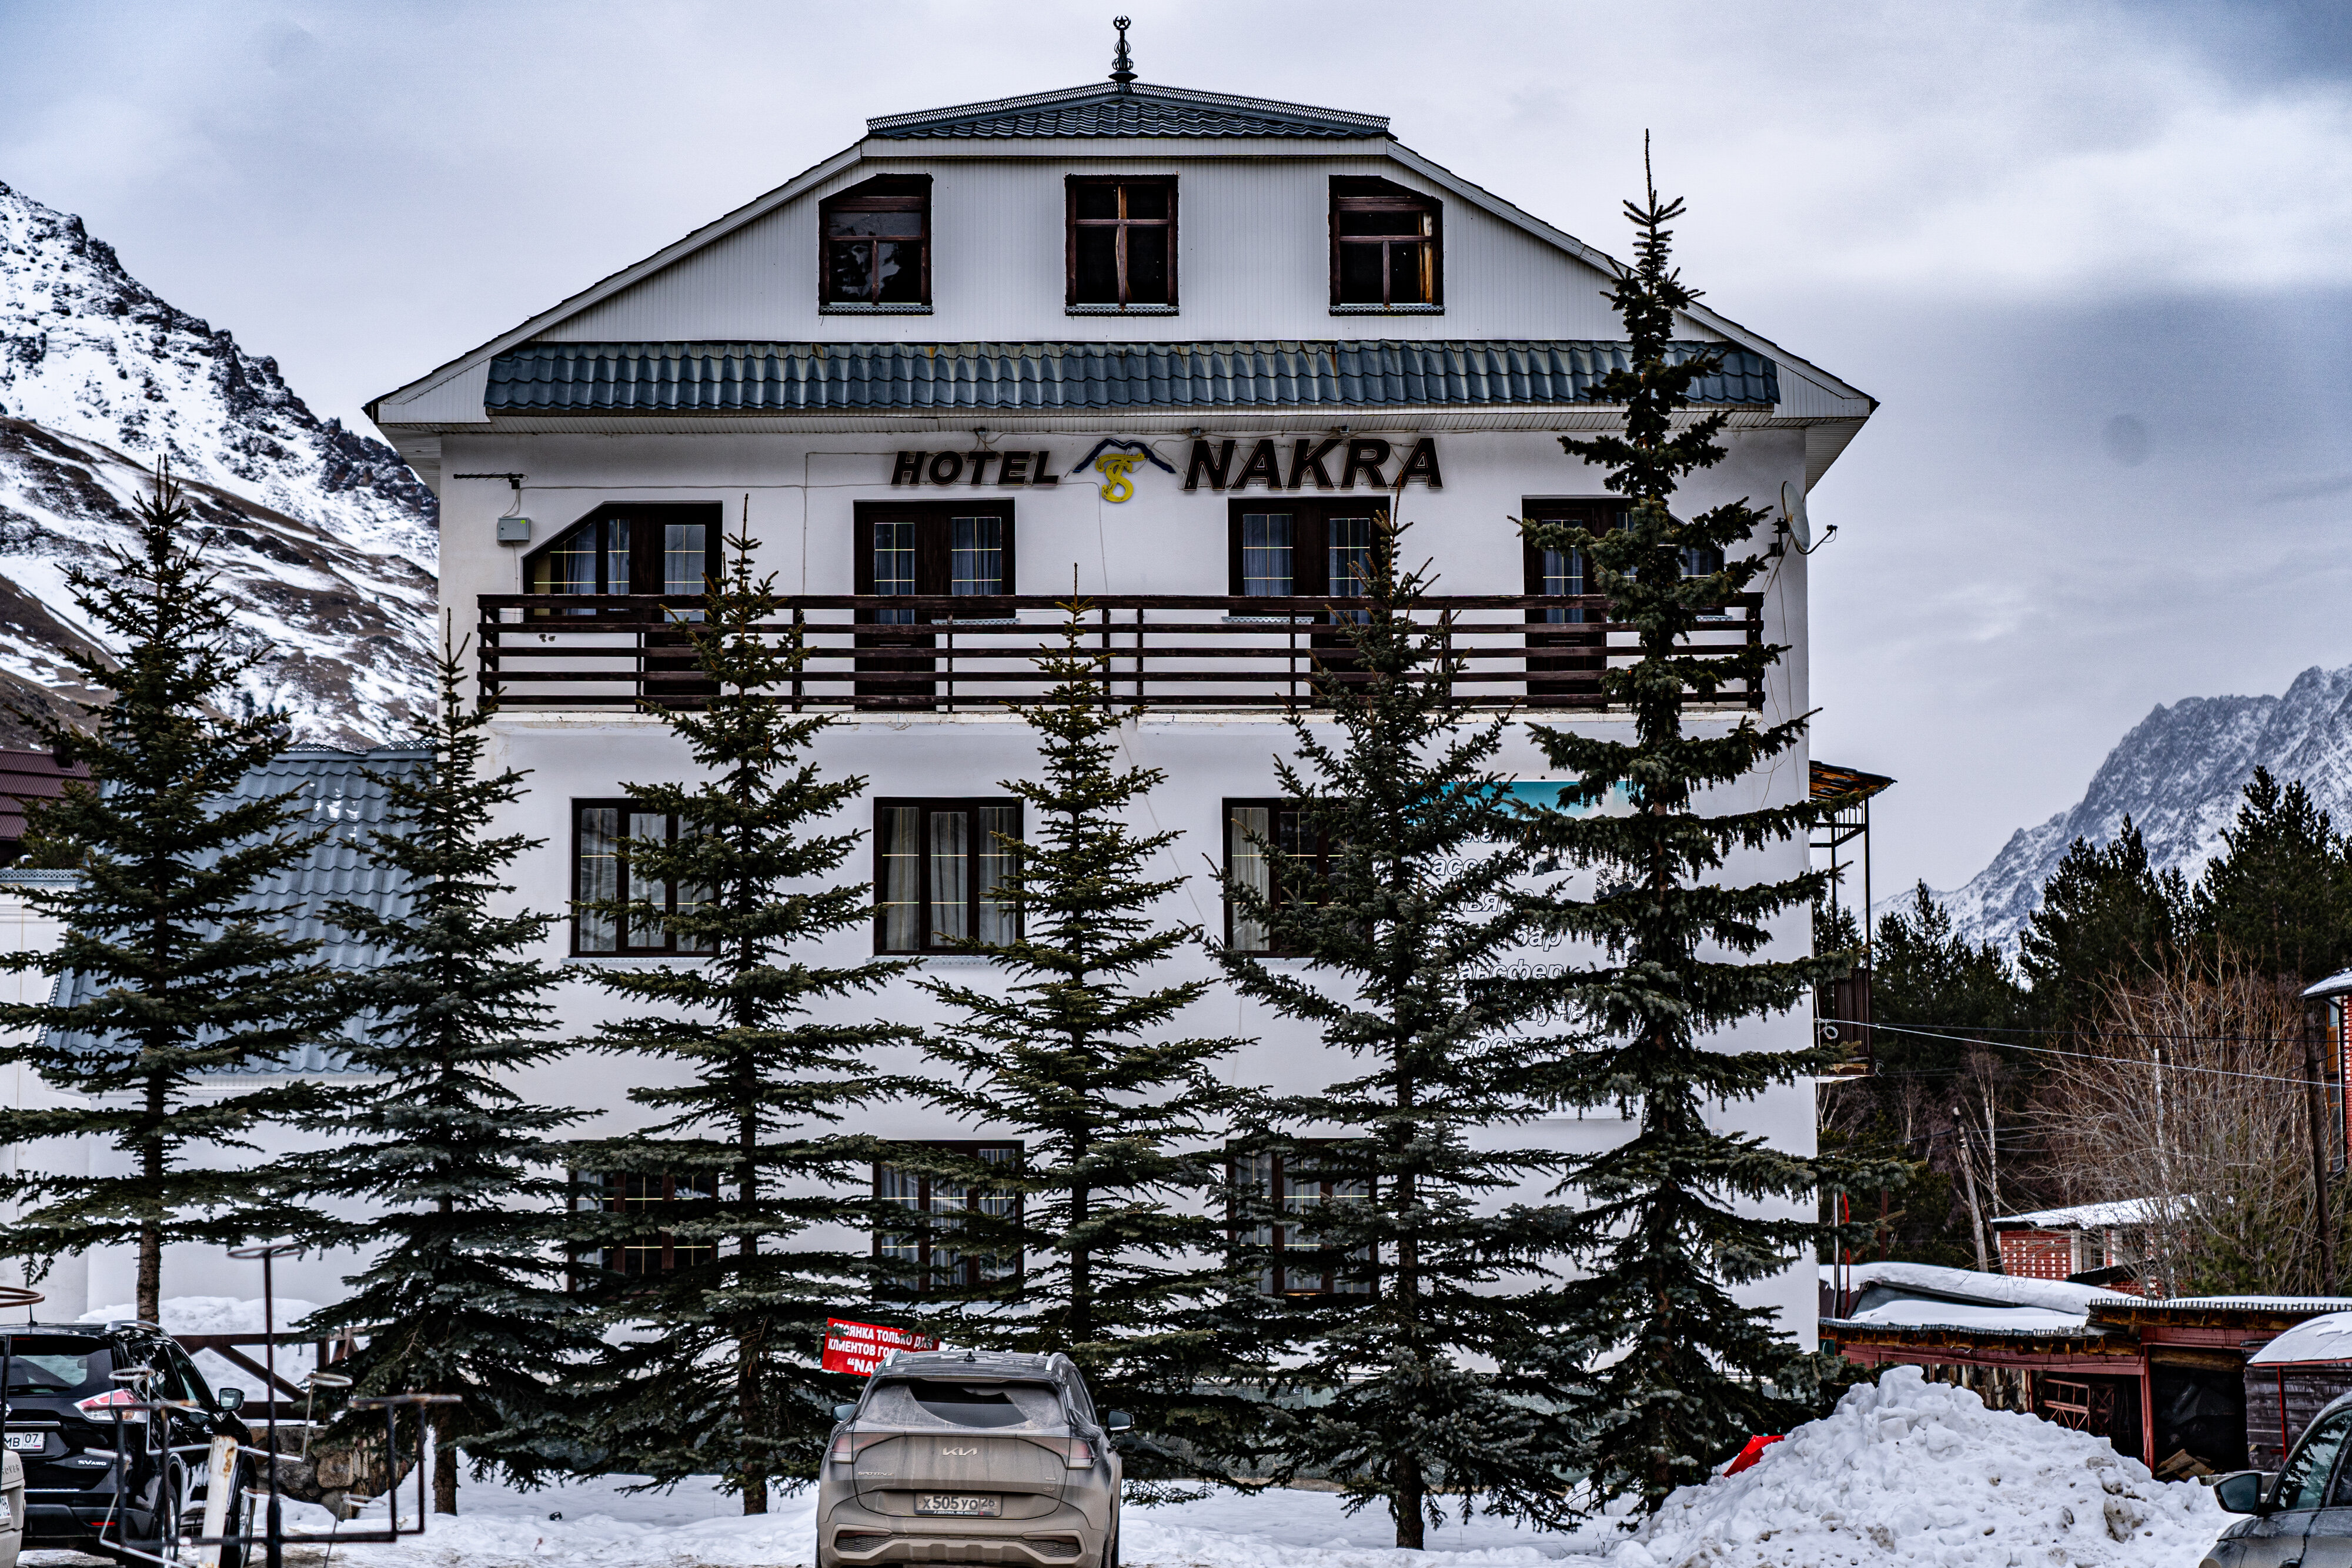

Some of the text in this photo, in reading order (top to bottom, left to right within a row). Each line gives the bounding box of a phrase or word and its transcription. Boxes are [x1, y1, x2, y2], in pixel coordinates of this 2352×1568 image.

[890, 450, 1059, 486] HOTEL
[1182, 437, 1444, 491] NAKRA
[1415, 850, 1526, 876] басс
[1459, 958, 1564, 981] ансфер
[876, 1329, 913, 1346] ТОЛЬКО
[827, 1338, 876, 1356] КЛИЕНТОВ
[25, 1433, 39, 1443] 07
[942, 1447, 977, 1456] KIA
[981, 1497, 995, 1507] 26
